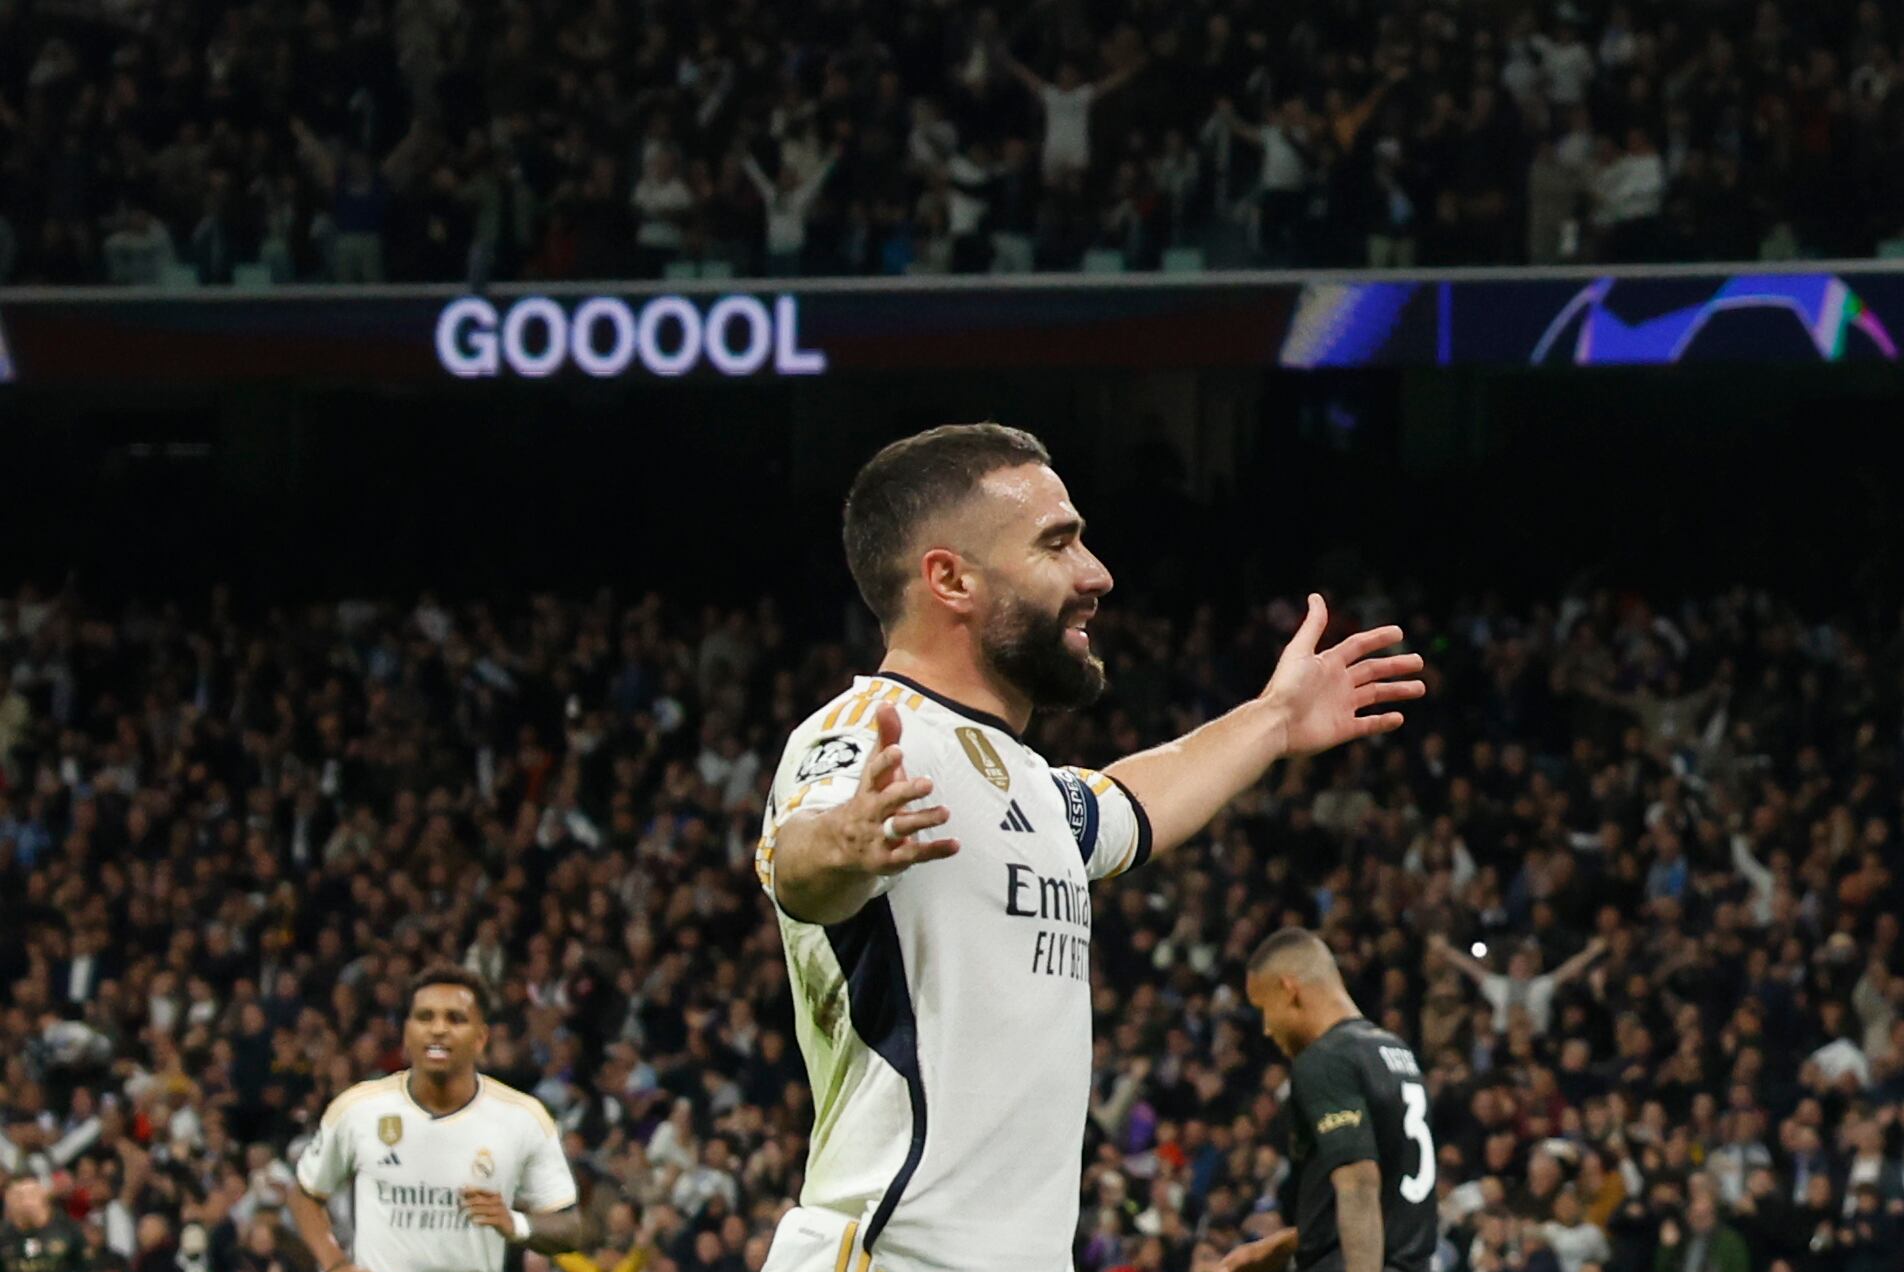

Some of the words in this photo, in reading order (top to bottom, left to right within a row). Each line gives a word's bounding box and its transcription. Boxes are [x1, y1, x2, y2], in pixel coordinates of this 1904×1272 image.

[436, 294, 827, 377] GOOOOL
[1032, 931, 1068, 976] FLY
[1400, 1082, 1437, 1204] 3
